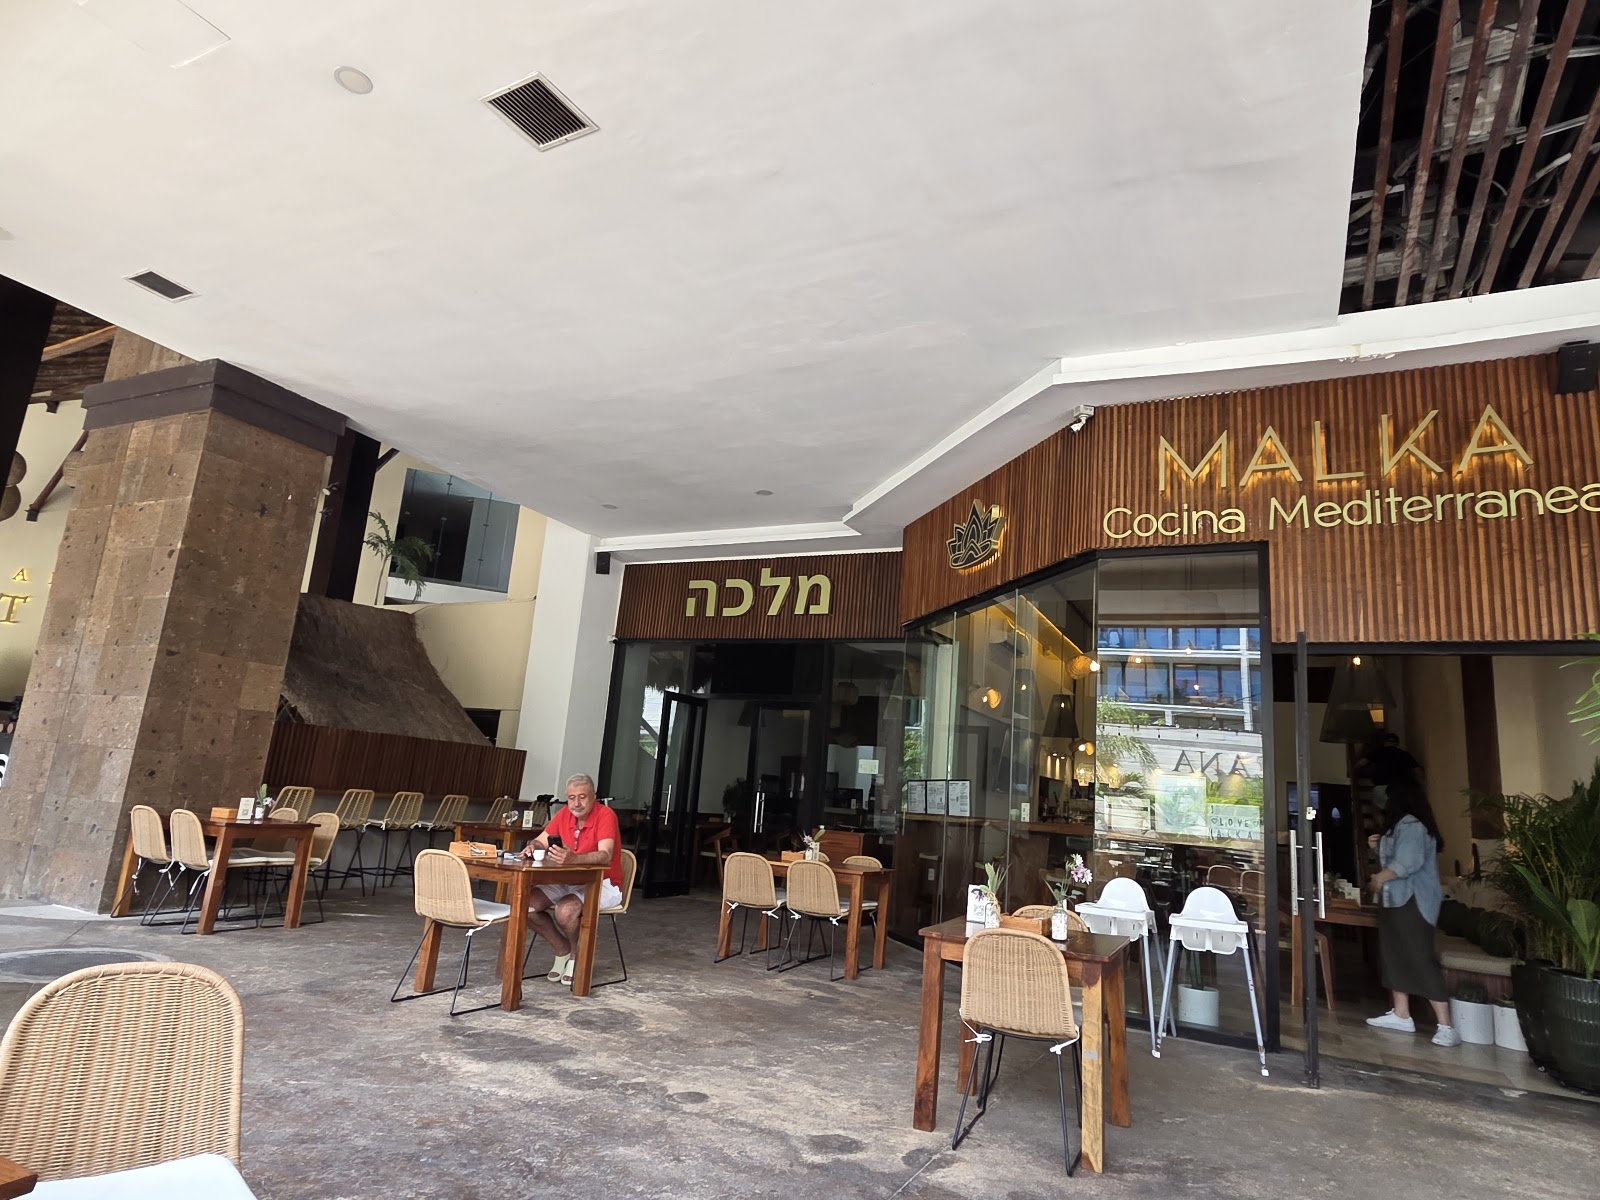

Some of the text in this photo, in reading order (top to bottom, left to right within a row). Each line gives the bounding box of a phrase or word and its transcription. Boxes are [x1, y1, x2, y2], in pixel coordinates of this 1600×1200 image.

[1158, 404, 1534, 490] MALKA
[1103, 483, 1600, 539] Cocina Mediterranea
[685, 567, 831, 617] מלכה
